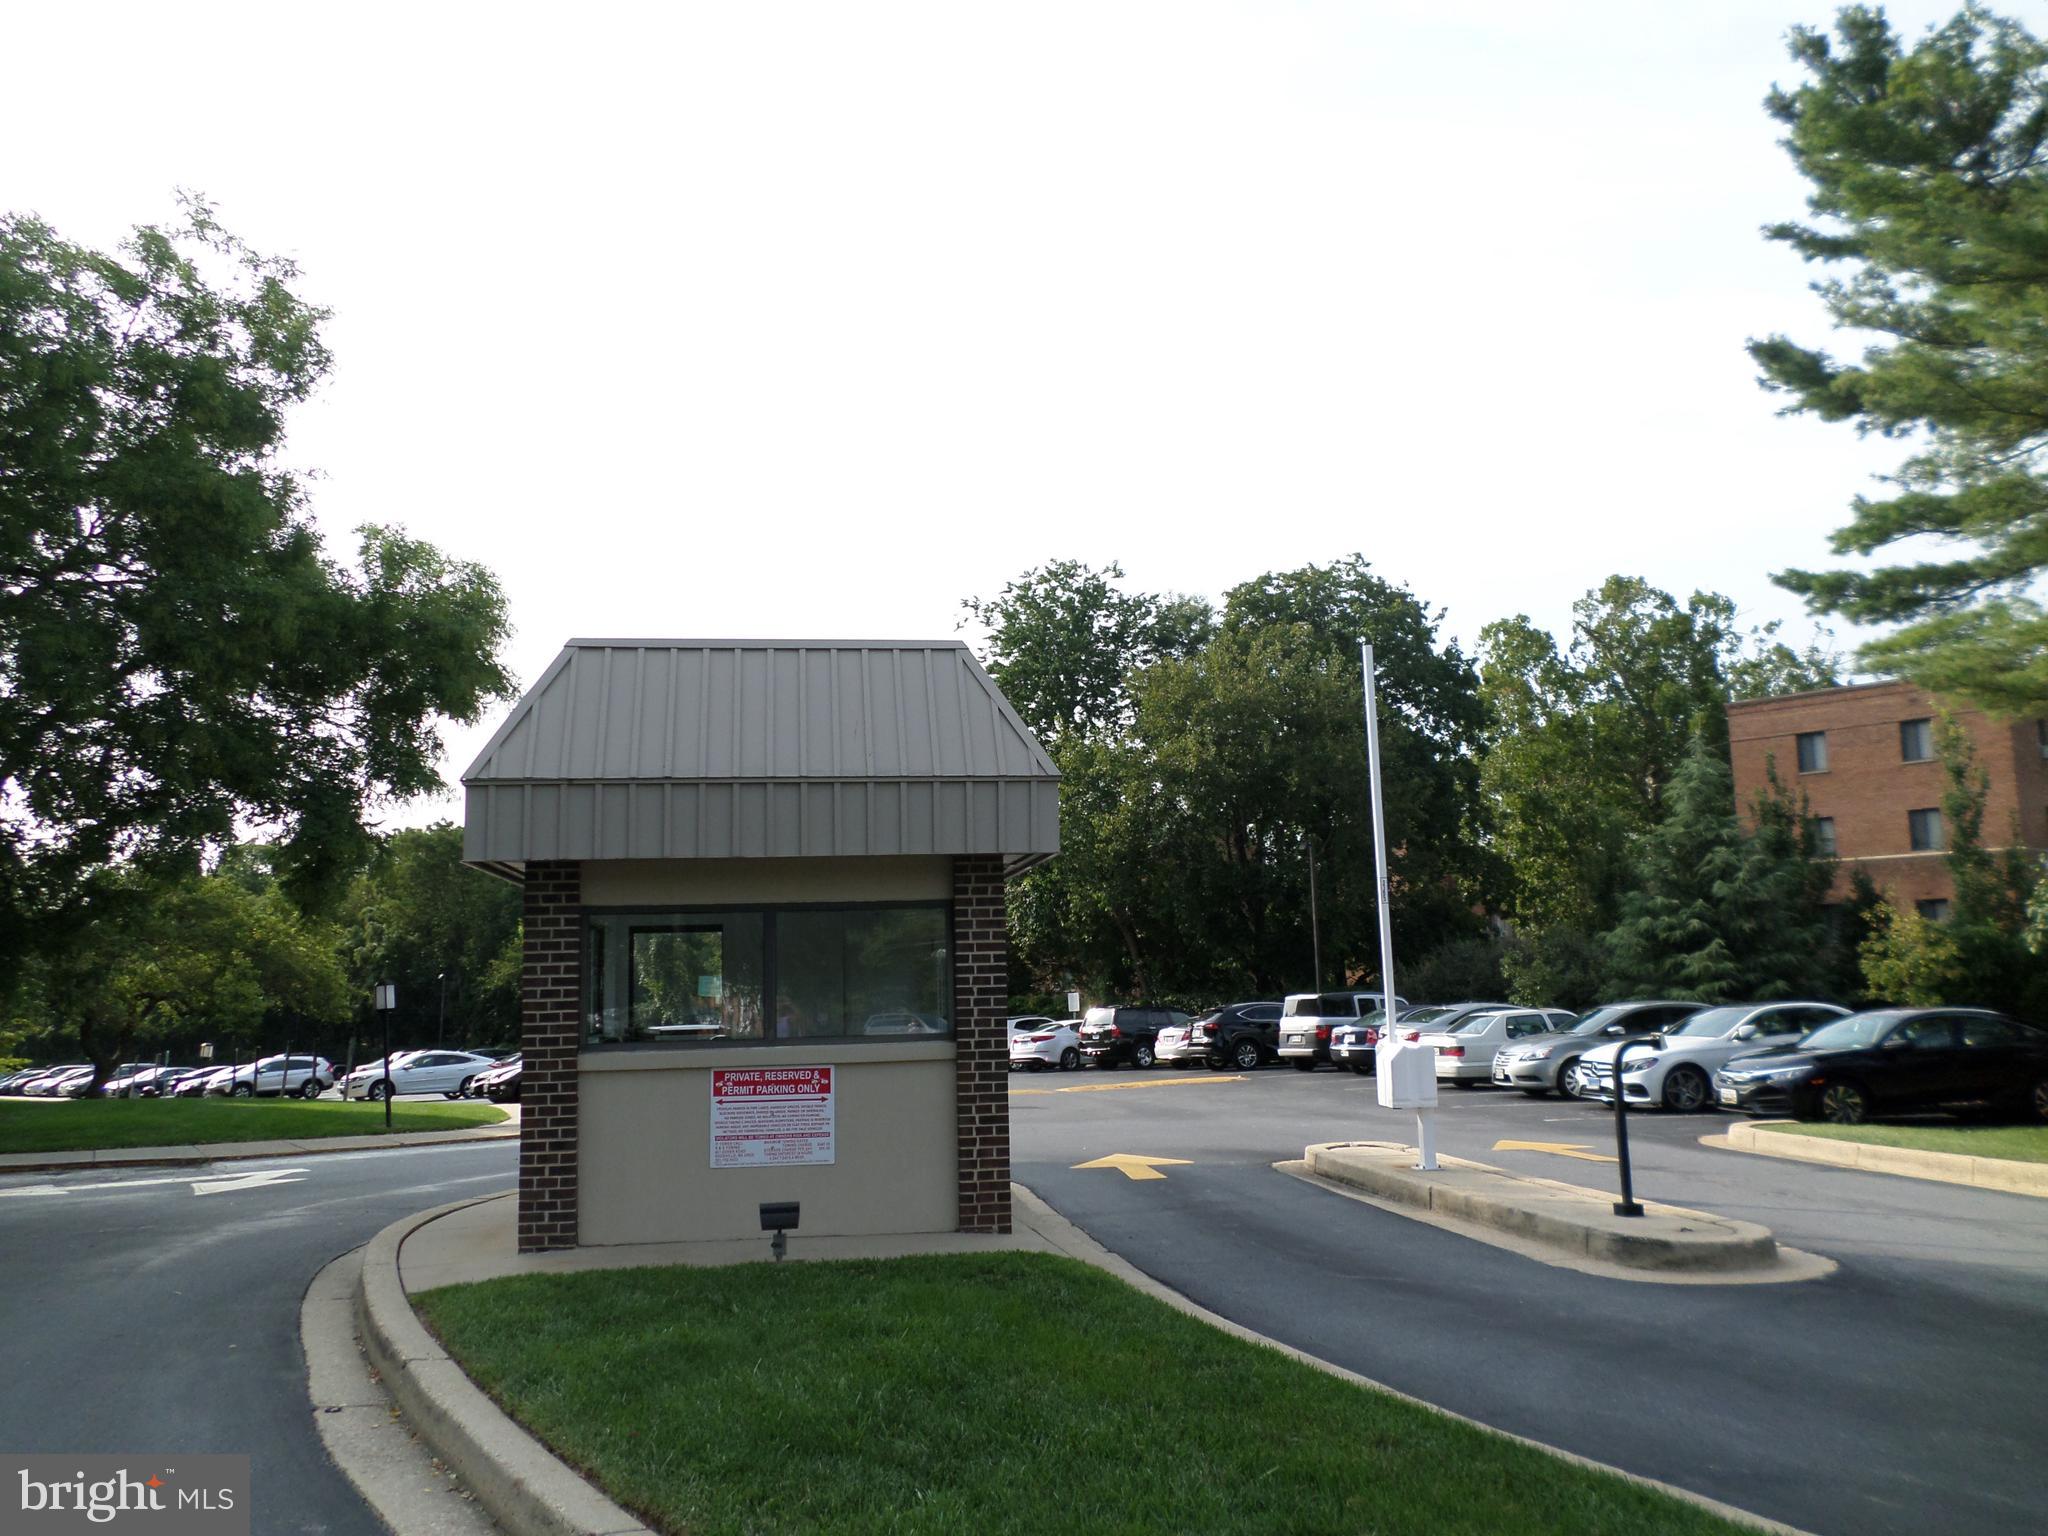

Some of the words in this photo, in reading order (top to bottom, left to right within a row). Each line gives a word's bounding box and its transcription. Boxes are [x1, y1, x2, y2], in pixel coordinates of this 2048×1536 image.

[724, 1071, 763, 1082] PRIVATE,
[764, 1070, 812, 1081] RESERVED
[813, 1070, 820, 1079] &
[721, 1085, 754, 1095] PERMIT
[756, 1084, 796, 1094] PARKING
[797, 1083, 820, 1093] ONLY
